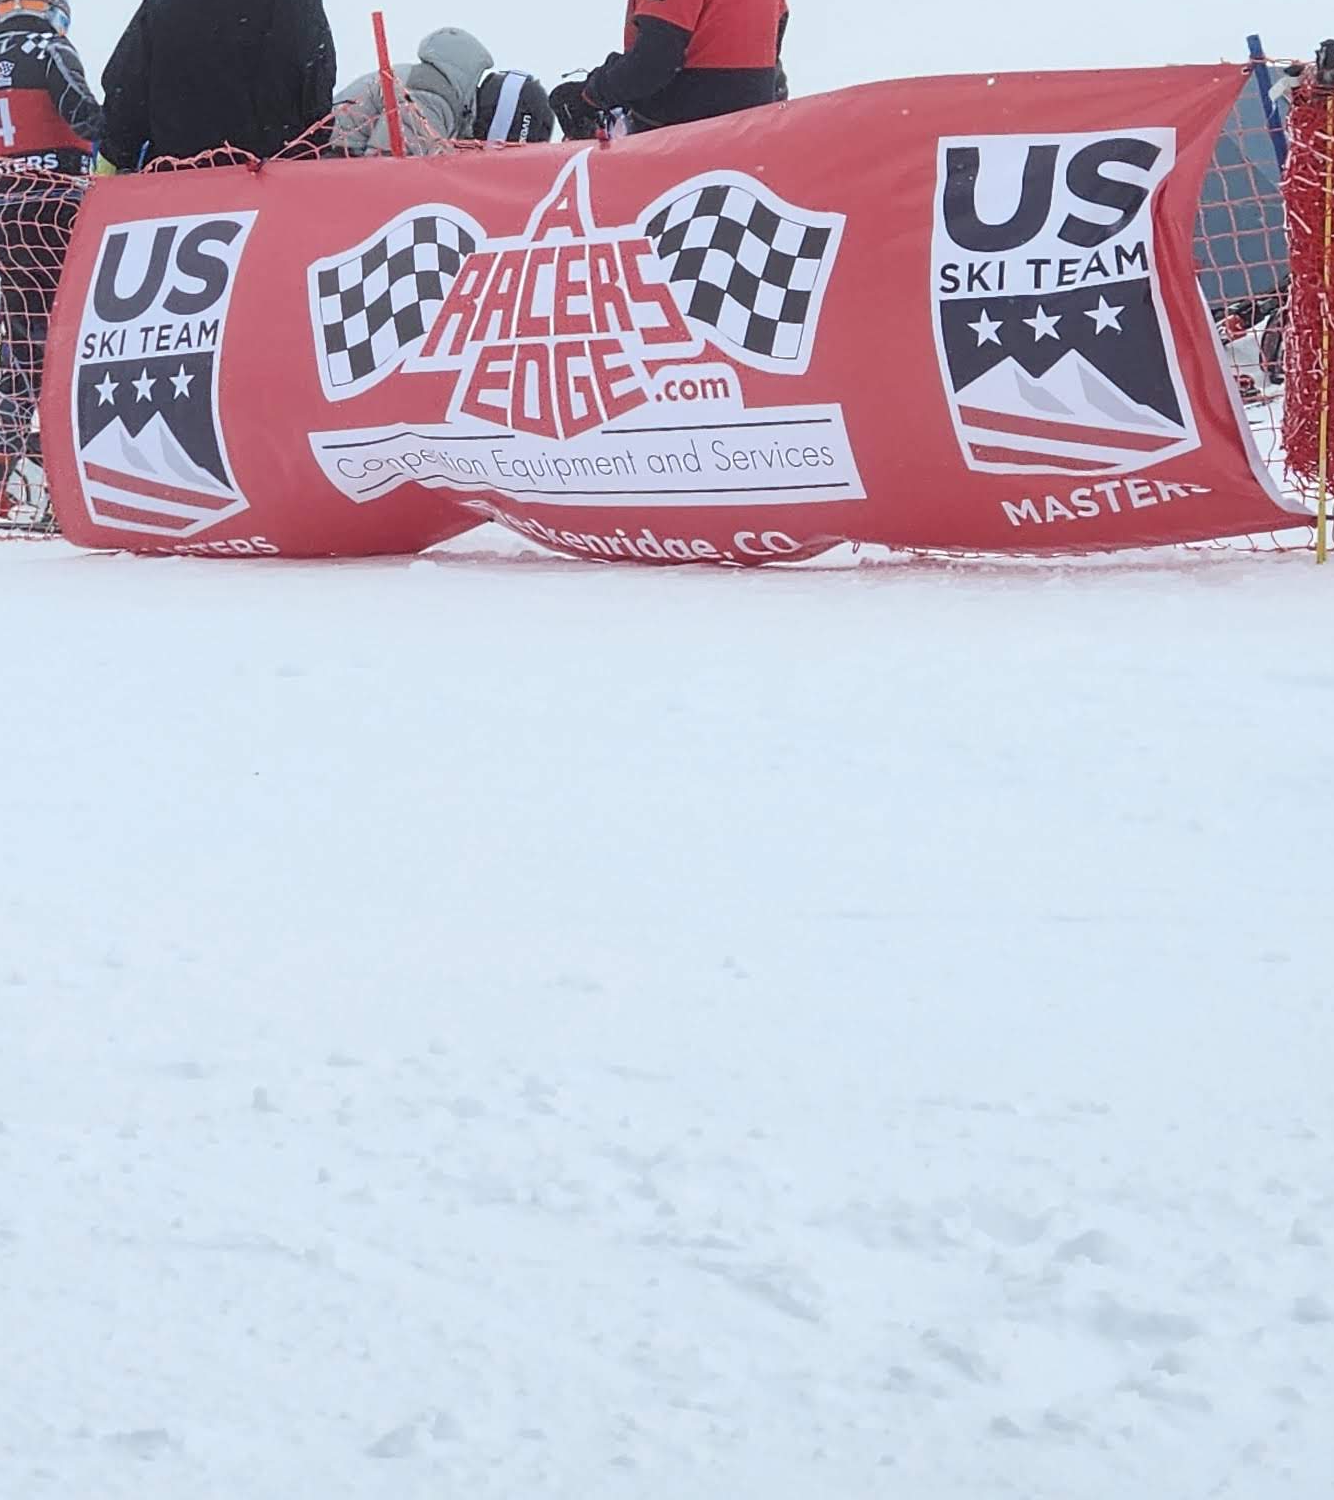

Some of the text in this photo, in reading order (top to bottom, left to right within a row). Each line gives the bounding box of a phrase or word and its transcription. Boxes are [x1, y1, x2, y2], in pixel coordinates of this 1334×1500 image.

[530, 164, 587, 242] A
[943, 137, 1163, 252] US
[93, 219, 244, 324] US
[419, 238, 693, 358] RACERS
[939, 240, 1150, 294] SKI TEAM
[81, 318, 221, 360] SKI TEAM
[460, 338, 731, 441] EDGE .com
[337, 438, 836, 486] Competion Equipment and Services
[484, 507, 804, 561] eckenridge, CO
